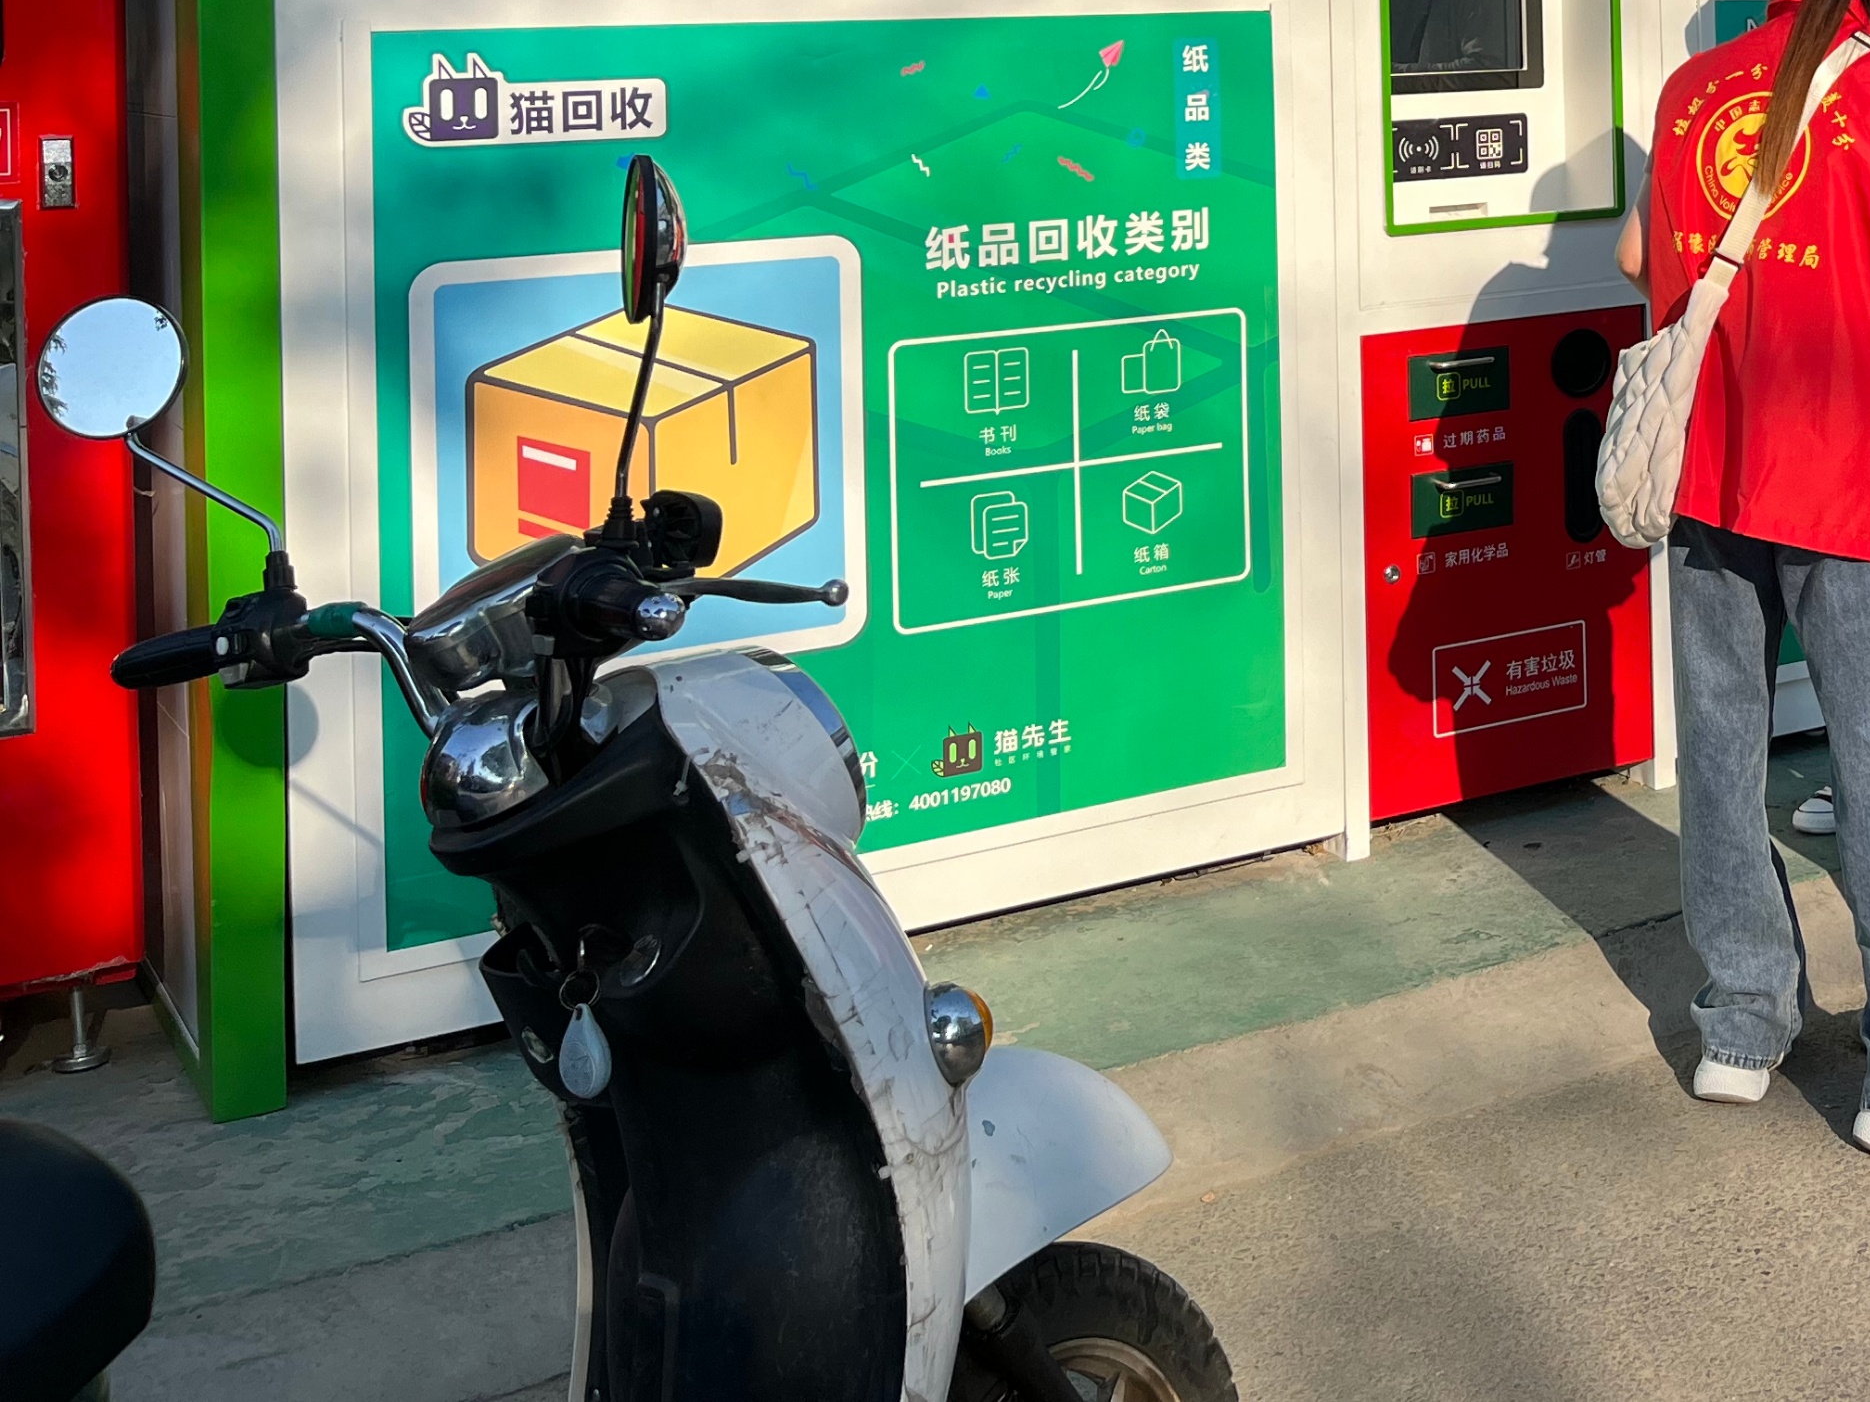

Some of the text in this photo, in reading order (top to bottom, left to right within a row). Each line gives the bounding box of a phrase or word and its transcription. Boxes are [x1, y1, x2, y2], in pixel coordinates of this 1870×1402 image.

[509, 86, 654, 135] 猫回收
[1181, 44, 1211, 171] 纸品类
[1704, 165, 1719, 198] China
[924, 206, 1210, 271] 纸品回收类别
[936, 262, 1200, 299] Plastic recycling category
[1442, 377, 1456, 395] 拉
[1462, 376, 1492, 390] PULL
[1133, 402, 1170, 422] 纸袋
[978, 423, 1018, 445] 书刊
[1131, 422, 1173, 435] Paper bag
[1442, 426, 1507, 449] 过期药品
[985, 446, 1012, 457] Books
[1445, 495, 1459, 512] 拉
[1465, 493, 1495, 508] PULL
[1133, 542, 1170, 564] 纸箱
[1444, 542, 1509, 568] 家用化学品
[1583, 549, 1607, 565] 灯管
[981, 565, 1021, 588] 纸张
[1139, 564, 1167, 576] Carton
[987, 589, 1013, 600] Paper
[1505, 648, 1577, 681] 有害垃圾
[1505, 672, 1578, 697] Hazardous Waste
[993, 718, 1073, 756] 猫先生
[908, 776, 1012, 812] 4001197080
